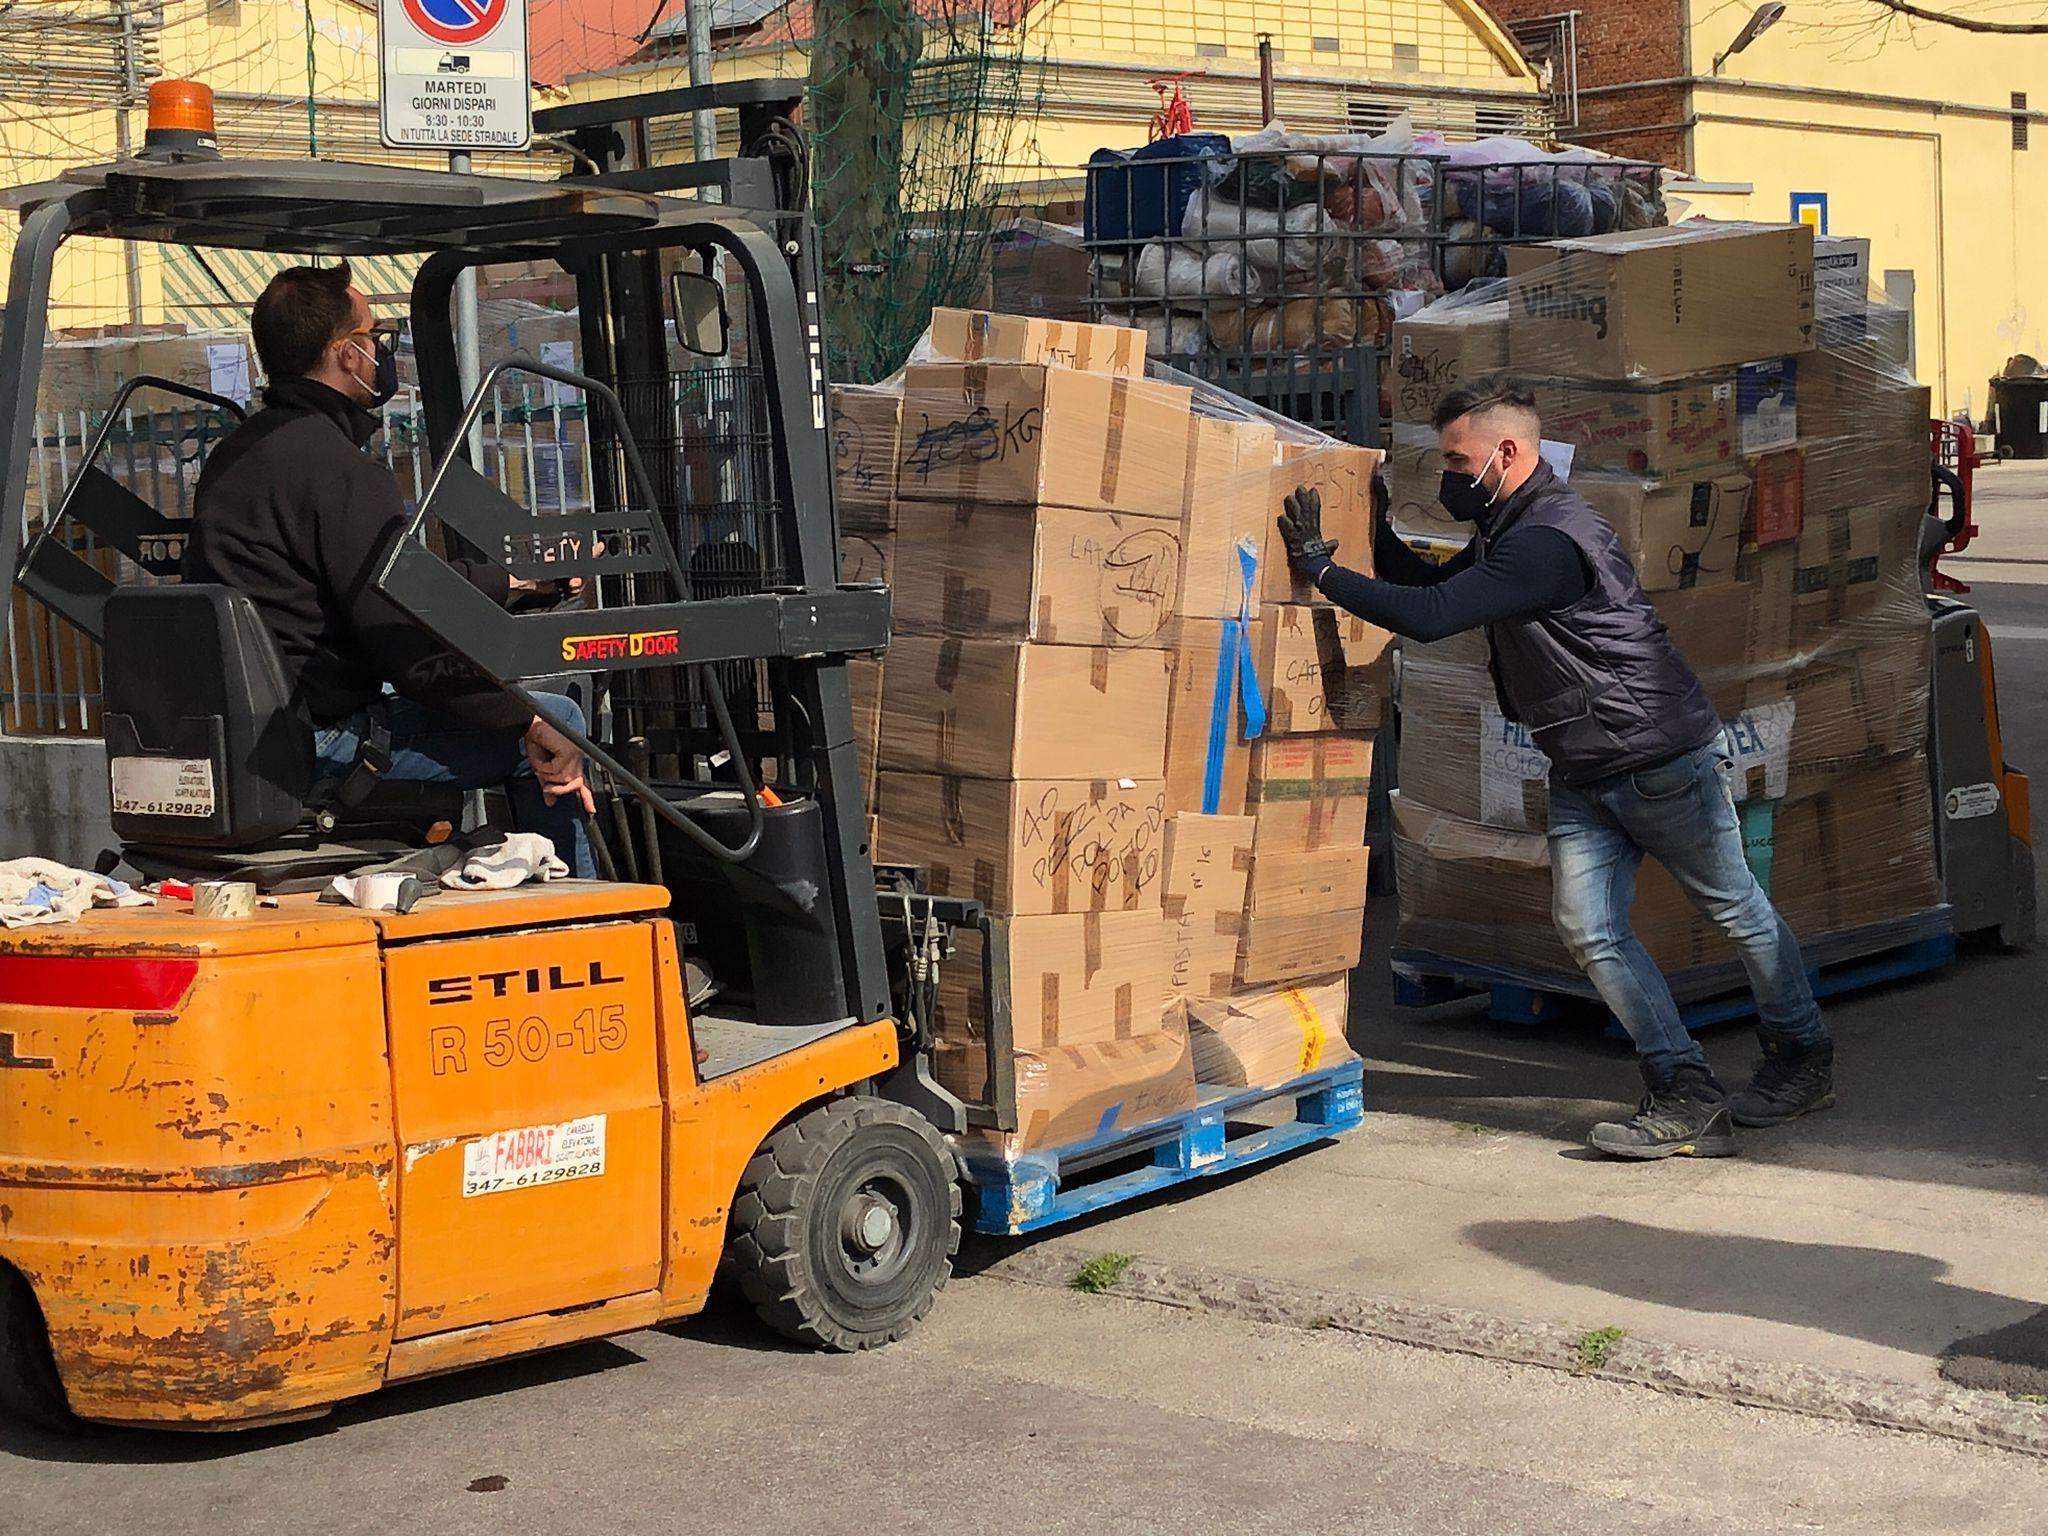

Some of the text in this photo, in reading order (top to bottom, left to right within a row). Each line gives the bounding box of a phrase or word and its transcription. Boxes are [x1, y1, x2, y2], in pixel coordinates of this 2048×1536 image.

[425, 81, 486, 94] MARTEDI
[412, 97, 496, 111] GIORNI DISPARI
[426, 115, 447, 127] 8:30
[457, 115, 484, 127] 10:30
[401, 128, 518, 143] IN TUTTA LA SEDE STRADALE
[562, 630, 679, 661] SAFETY DOOR
[115, 800, 212, 815] 347-6129828
[429, 961, 624, 1005] STILL
[431, 1004, 628, 1075] R 50-15
[495, 1129, 554, 1175] FABBRI
[466, 1162, 601, 1194] 347-6129828
